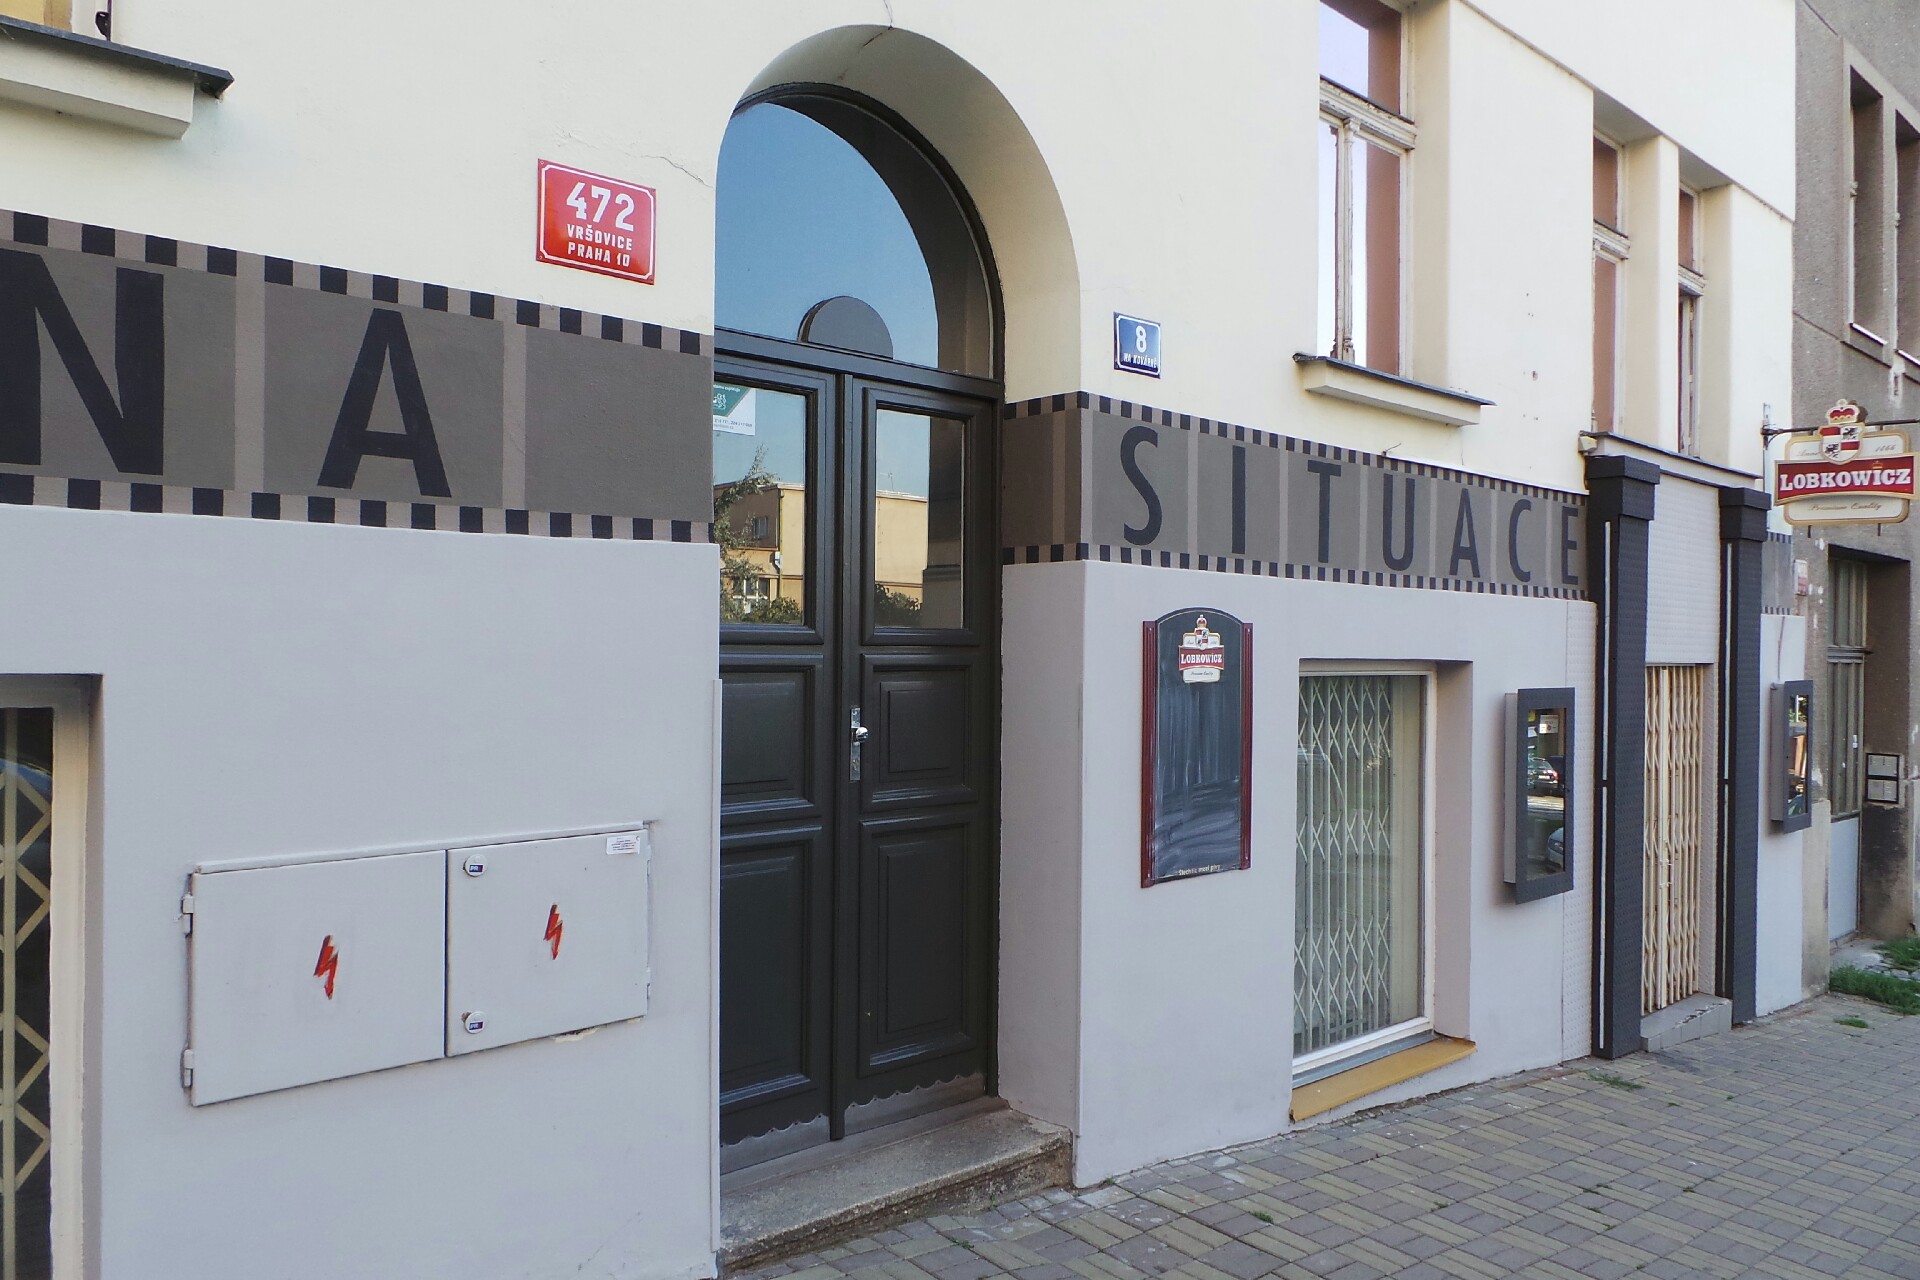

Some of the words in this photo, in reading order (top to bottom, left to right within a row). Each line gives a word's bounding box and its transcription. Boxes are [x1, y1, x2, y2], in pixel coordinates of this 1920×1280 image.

[566, 182, 634, 232] 472
[566, 223, 632, 251] VRŠOVICE
[567, 241, 611, 263] PRAHA
[617, 252, 630, 267] 10
[1136, 326, 1146, 353] 8
[1780, 469, 1911, 490] LOBKOWICZ
[1119, 425, 1579, 585] SITUACE
[1181, 654, 1222, 664] LOBKOWICZ
